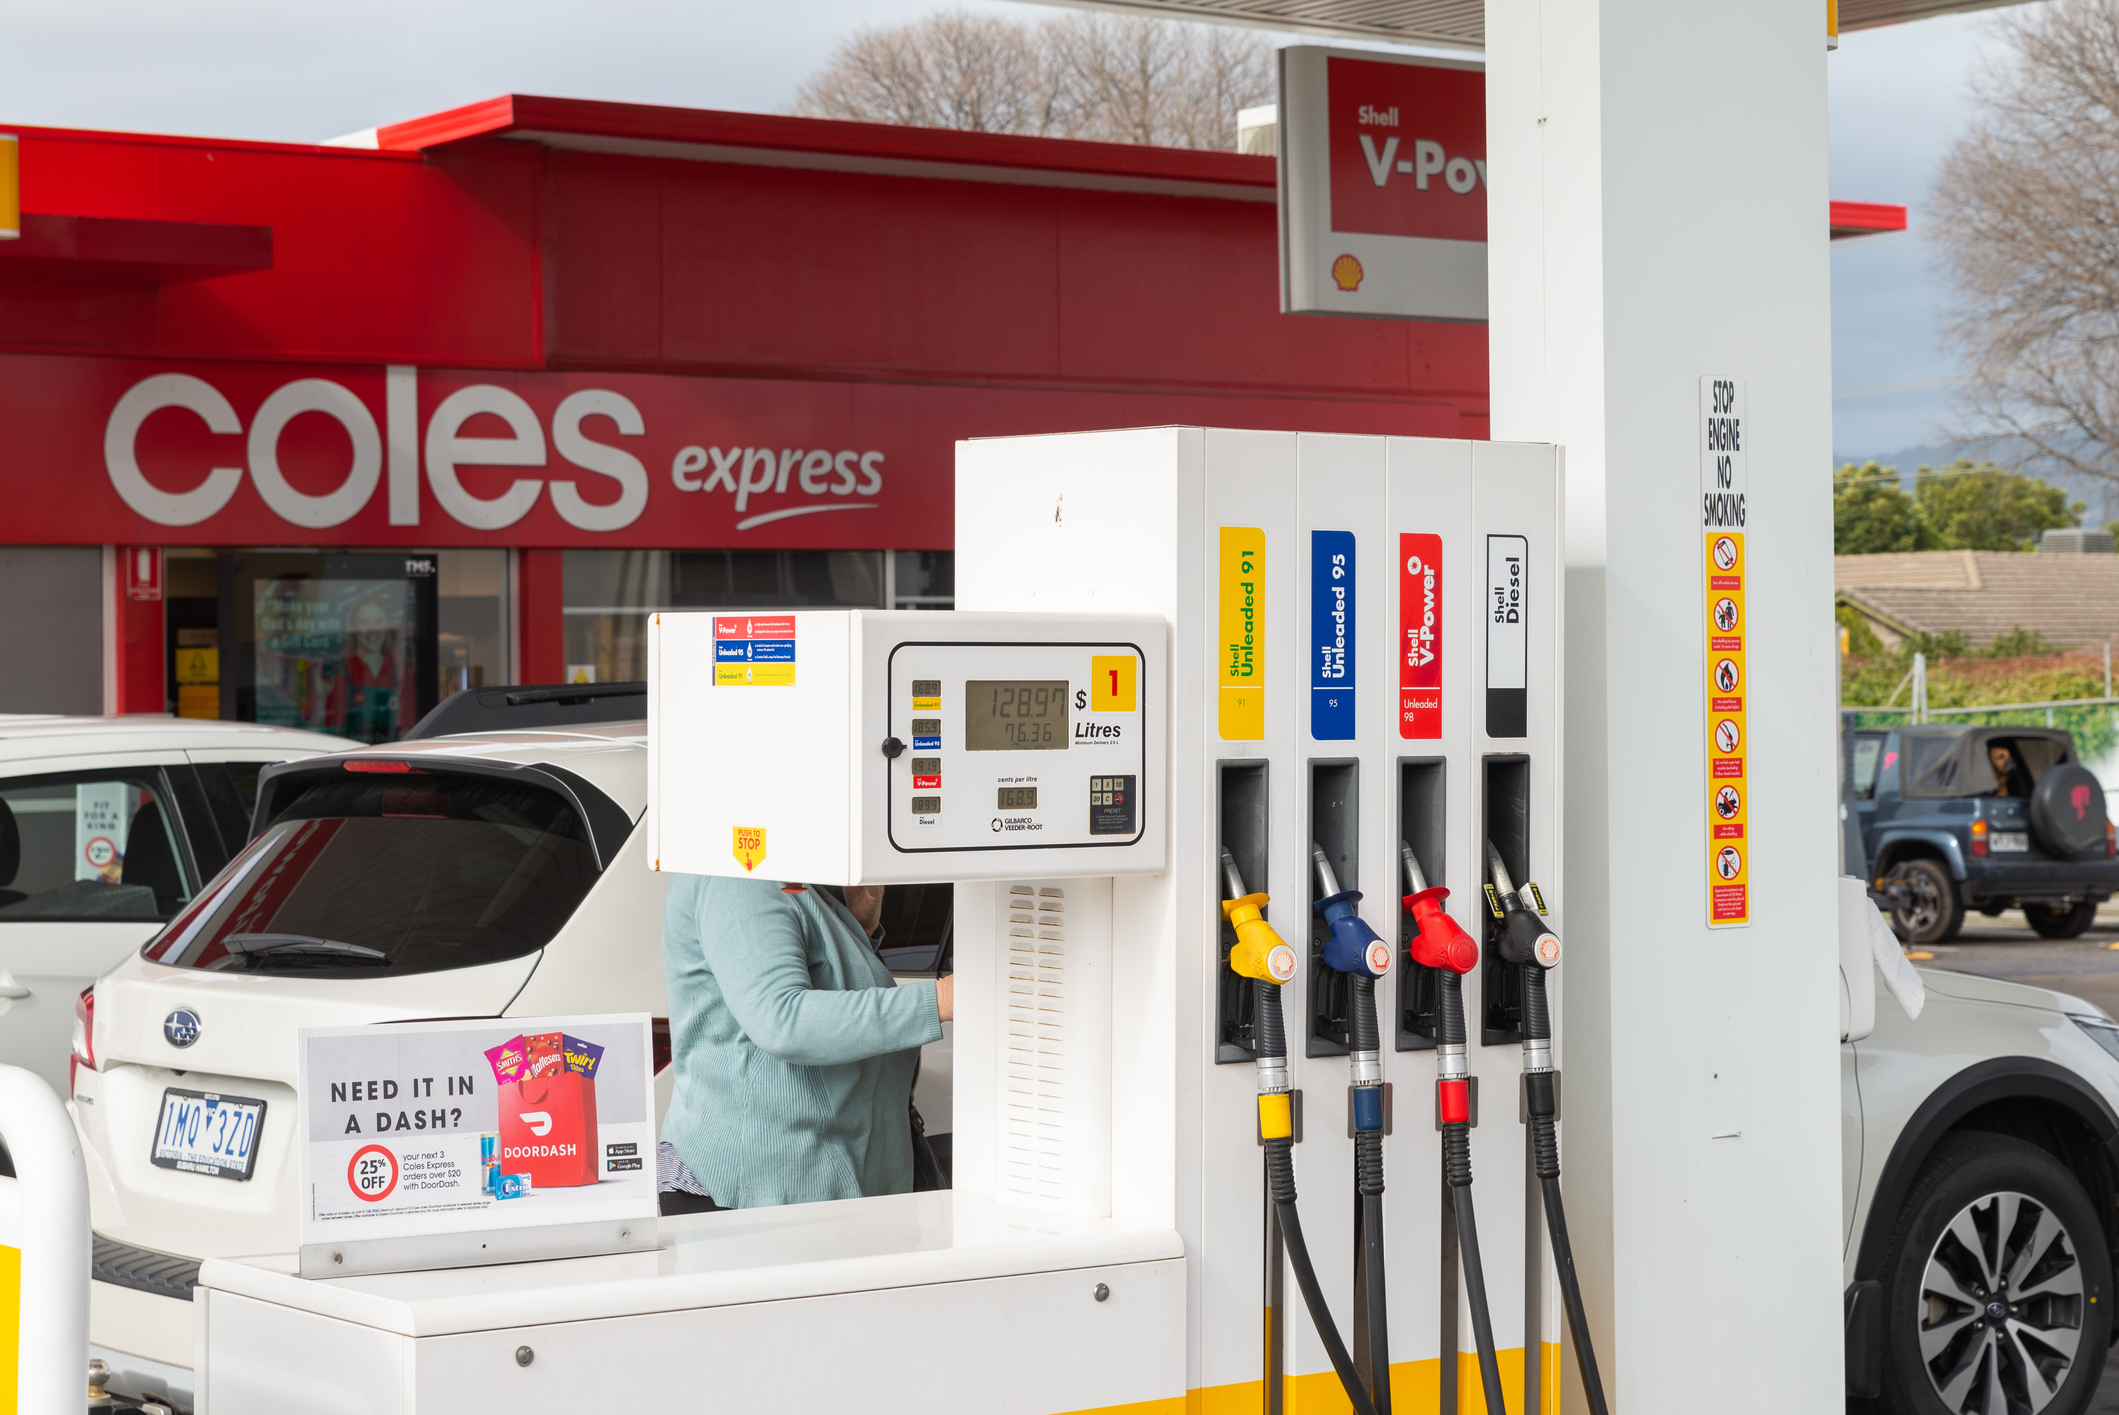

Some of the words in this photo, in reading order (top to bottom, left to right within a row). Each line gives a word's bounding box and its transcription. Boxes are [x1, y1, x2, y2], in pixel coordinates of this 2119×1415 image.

[1358, 105, 1399, 127] Shell
[1713, 380, 1734, 414] STOP
[1708, 417, 1740, 452] ENGINE
[104, 364, 649, 532] coles
[671, 445, 885, 512] express
[1718, 455, 1732, 489] NO
[1704, 492, 1745, 527] SMOKING
[1241, 550, 1254, 574] 91
[1332, 554, 1345, 579] 95
[1506, 557, 1520, 624] Diesel
[1420, 564, 1435, 667] V-Power
[1495, 587, 1504, 624] Shell
[1240, 582, 1254, 677] Unleaded
[1332, 587, 1345, 678] Unleaded
[1408, 630, 1419, 667] Shell
[1230, 644, 1239, 677] Shell
[1322, 646, 1332, 678] Shell
[914, 684, 938, 694] 168.9
[1109, 670, 1118, 696] 1
[992, 688, 1066, 718] 128.97
[1075, 689, 1087, 711] $
[1238, 698, 1246, 707] 91
[1329, 699, 1338, 708] 95
[1404, 698, 1438, 709] Unleaded
[914, 722, 937, 733] 185.9
[1404, 712, 1414, 722] 98
[1005, 723, 1051, 742] 76.36
[1075, 722, 1121, 738] Litres
[1002, 791, 1034, 806] 168.9
[738, 829, 752, 837] PUSH
[753, 830, 761, 838] TO
[739, 837, 760, 850] STOP
[564, 1052, 596, 1071] Twirl
[331, 1080, 399, 1103] NEED
[414, 1078, 434, 1098] IT
[449, 1076, 474, 1096] IN
[345, 1114, 362, 1134] A
[377, 1108, 462, 1132] DASH?
[160, 1149, 183, 1160] VICTORIA
[188, 1153, 198, 1161] THE
[198, 1154, 228, 1169] EDUCATION
[227, 1160, 245, 1171] STATE
[403, 1154, 420, 1163] your
[422, 1151, 438, 1160] next
[440, 1151, 445, 1159] 3
[504, 1144, 576, 1159] DOORDASH
[176, 1161, 196, 1172] SUBARU
[196, 1164, 220, 1176] HAMILTON
[360, 1159, 387, 1175] 25%
[403, 1163, 425, 1171] Coles
[427, 1161, 455, 1170] Express
[403, 1172, 428, 1181] orders
[448, 1169, 461, 1178] $20
[362, 1176, 386, 1190] OFF
[404, 1182, 419, 1191] with
[421, 1180, 461, 1190] DoorDash.
[506, 1183, 530, 1193] Extra
